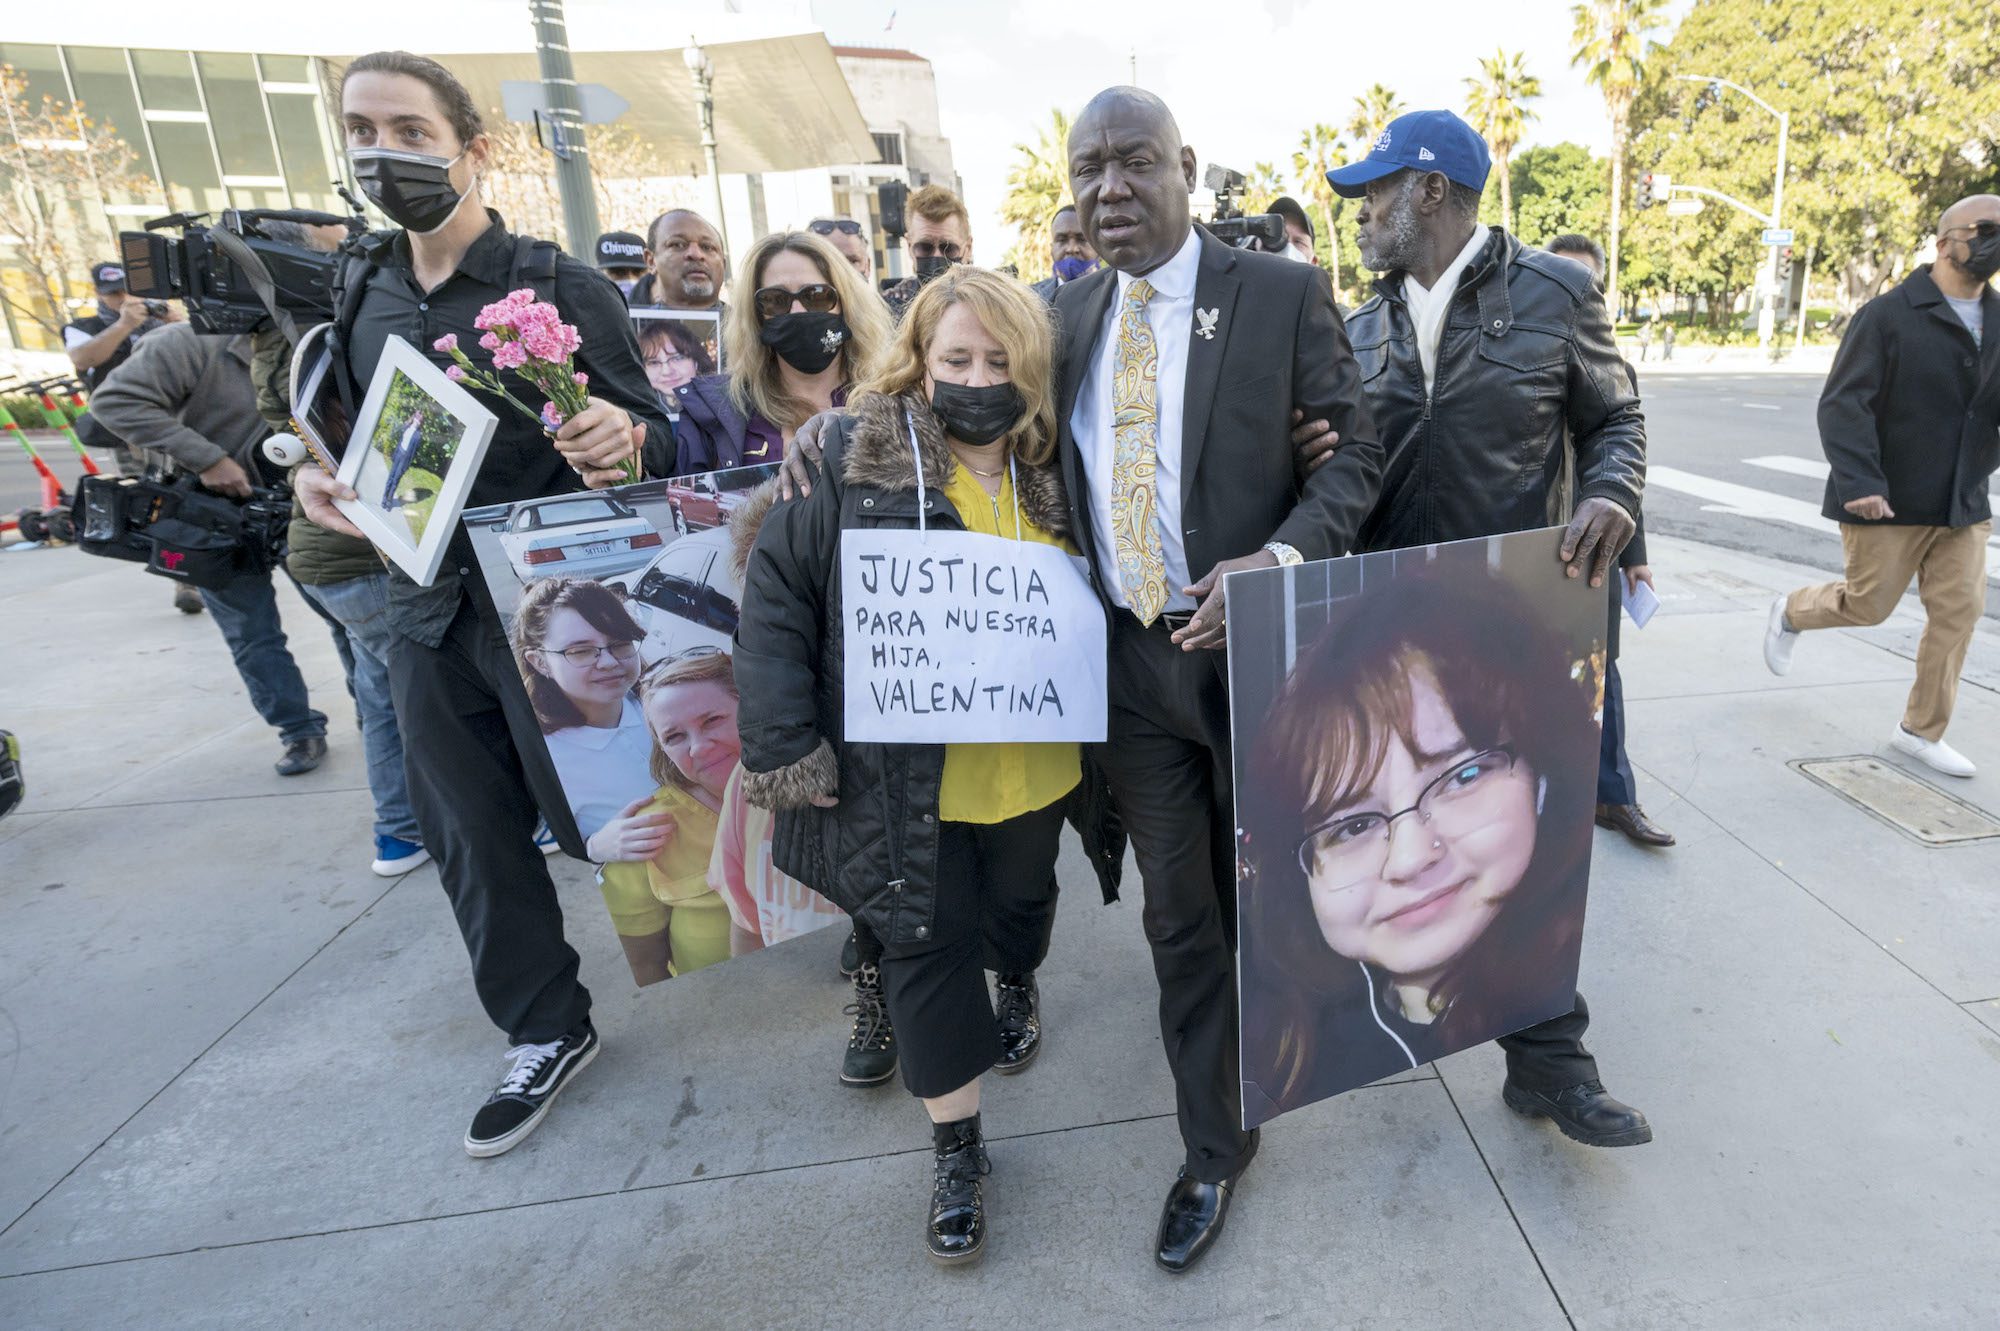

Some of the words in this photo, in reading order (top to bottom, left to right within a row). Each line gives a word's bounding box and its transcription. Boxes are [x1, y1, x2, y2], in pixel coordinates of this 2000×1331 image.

[859, 555, 1049, 605] JUSTICIA
[856, 607, 925, 637] PARA
[946, 606, 1056, 642] NUESTRA
[872, 642, 940, 670] HIJA,
[871, 677, 1063, 717] VALENTINA
